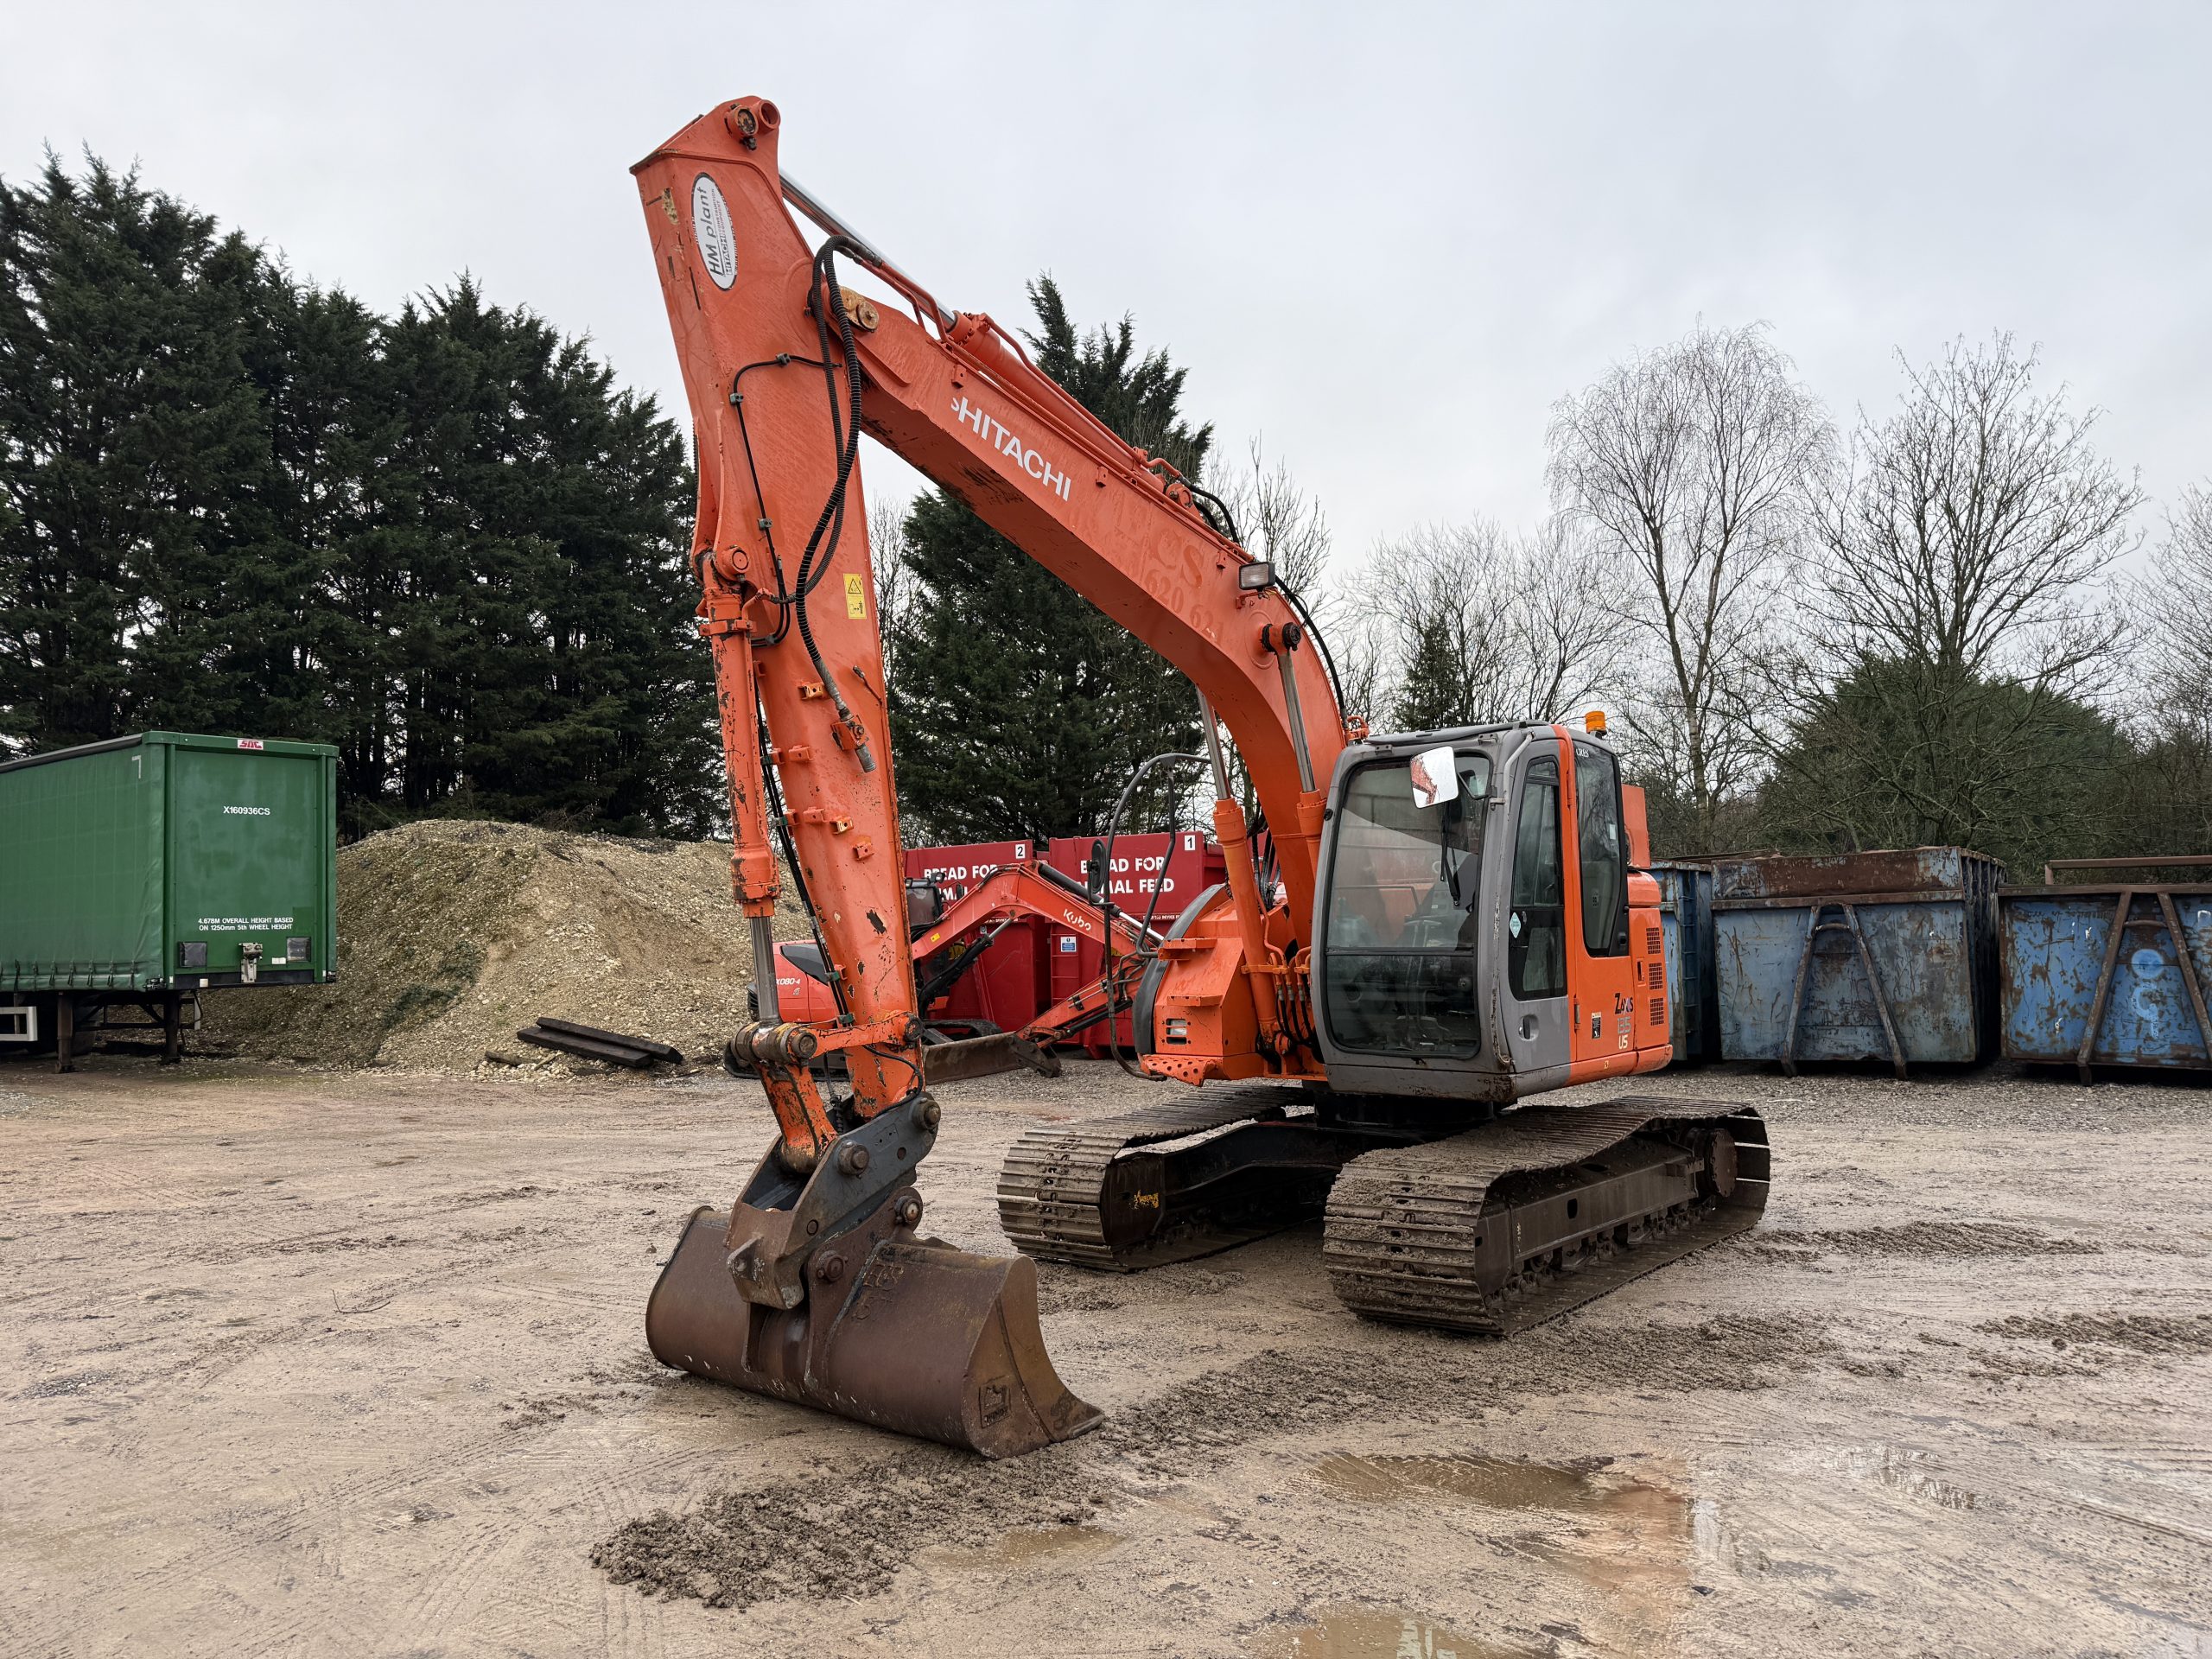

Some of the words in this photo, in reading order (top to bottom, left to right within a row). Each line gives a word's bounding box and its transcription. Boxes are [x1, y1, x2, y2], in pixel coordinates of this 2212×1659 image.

[697, 187, 716, 238] plant
[706, 244, 725, 276] HM
[719, 233, 733, 276] HITACHI
[958, 396, 1071, 502] HITACHI
[223, 805, 270, 816] X160936CS
[1017, 846, 1024, 857] 2
[1187, 836, 1192, 849] 1
[1080, 858, 1129, 874] BAD
[1135, 856, 1166, 872] FOR
[1618, 1034, 1629, 1050] US
